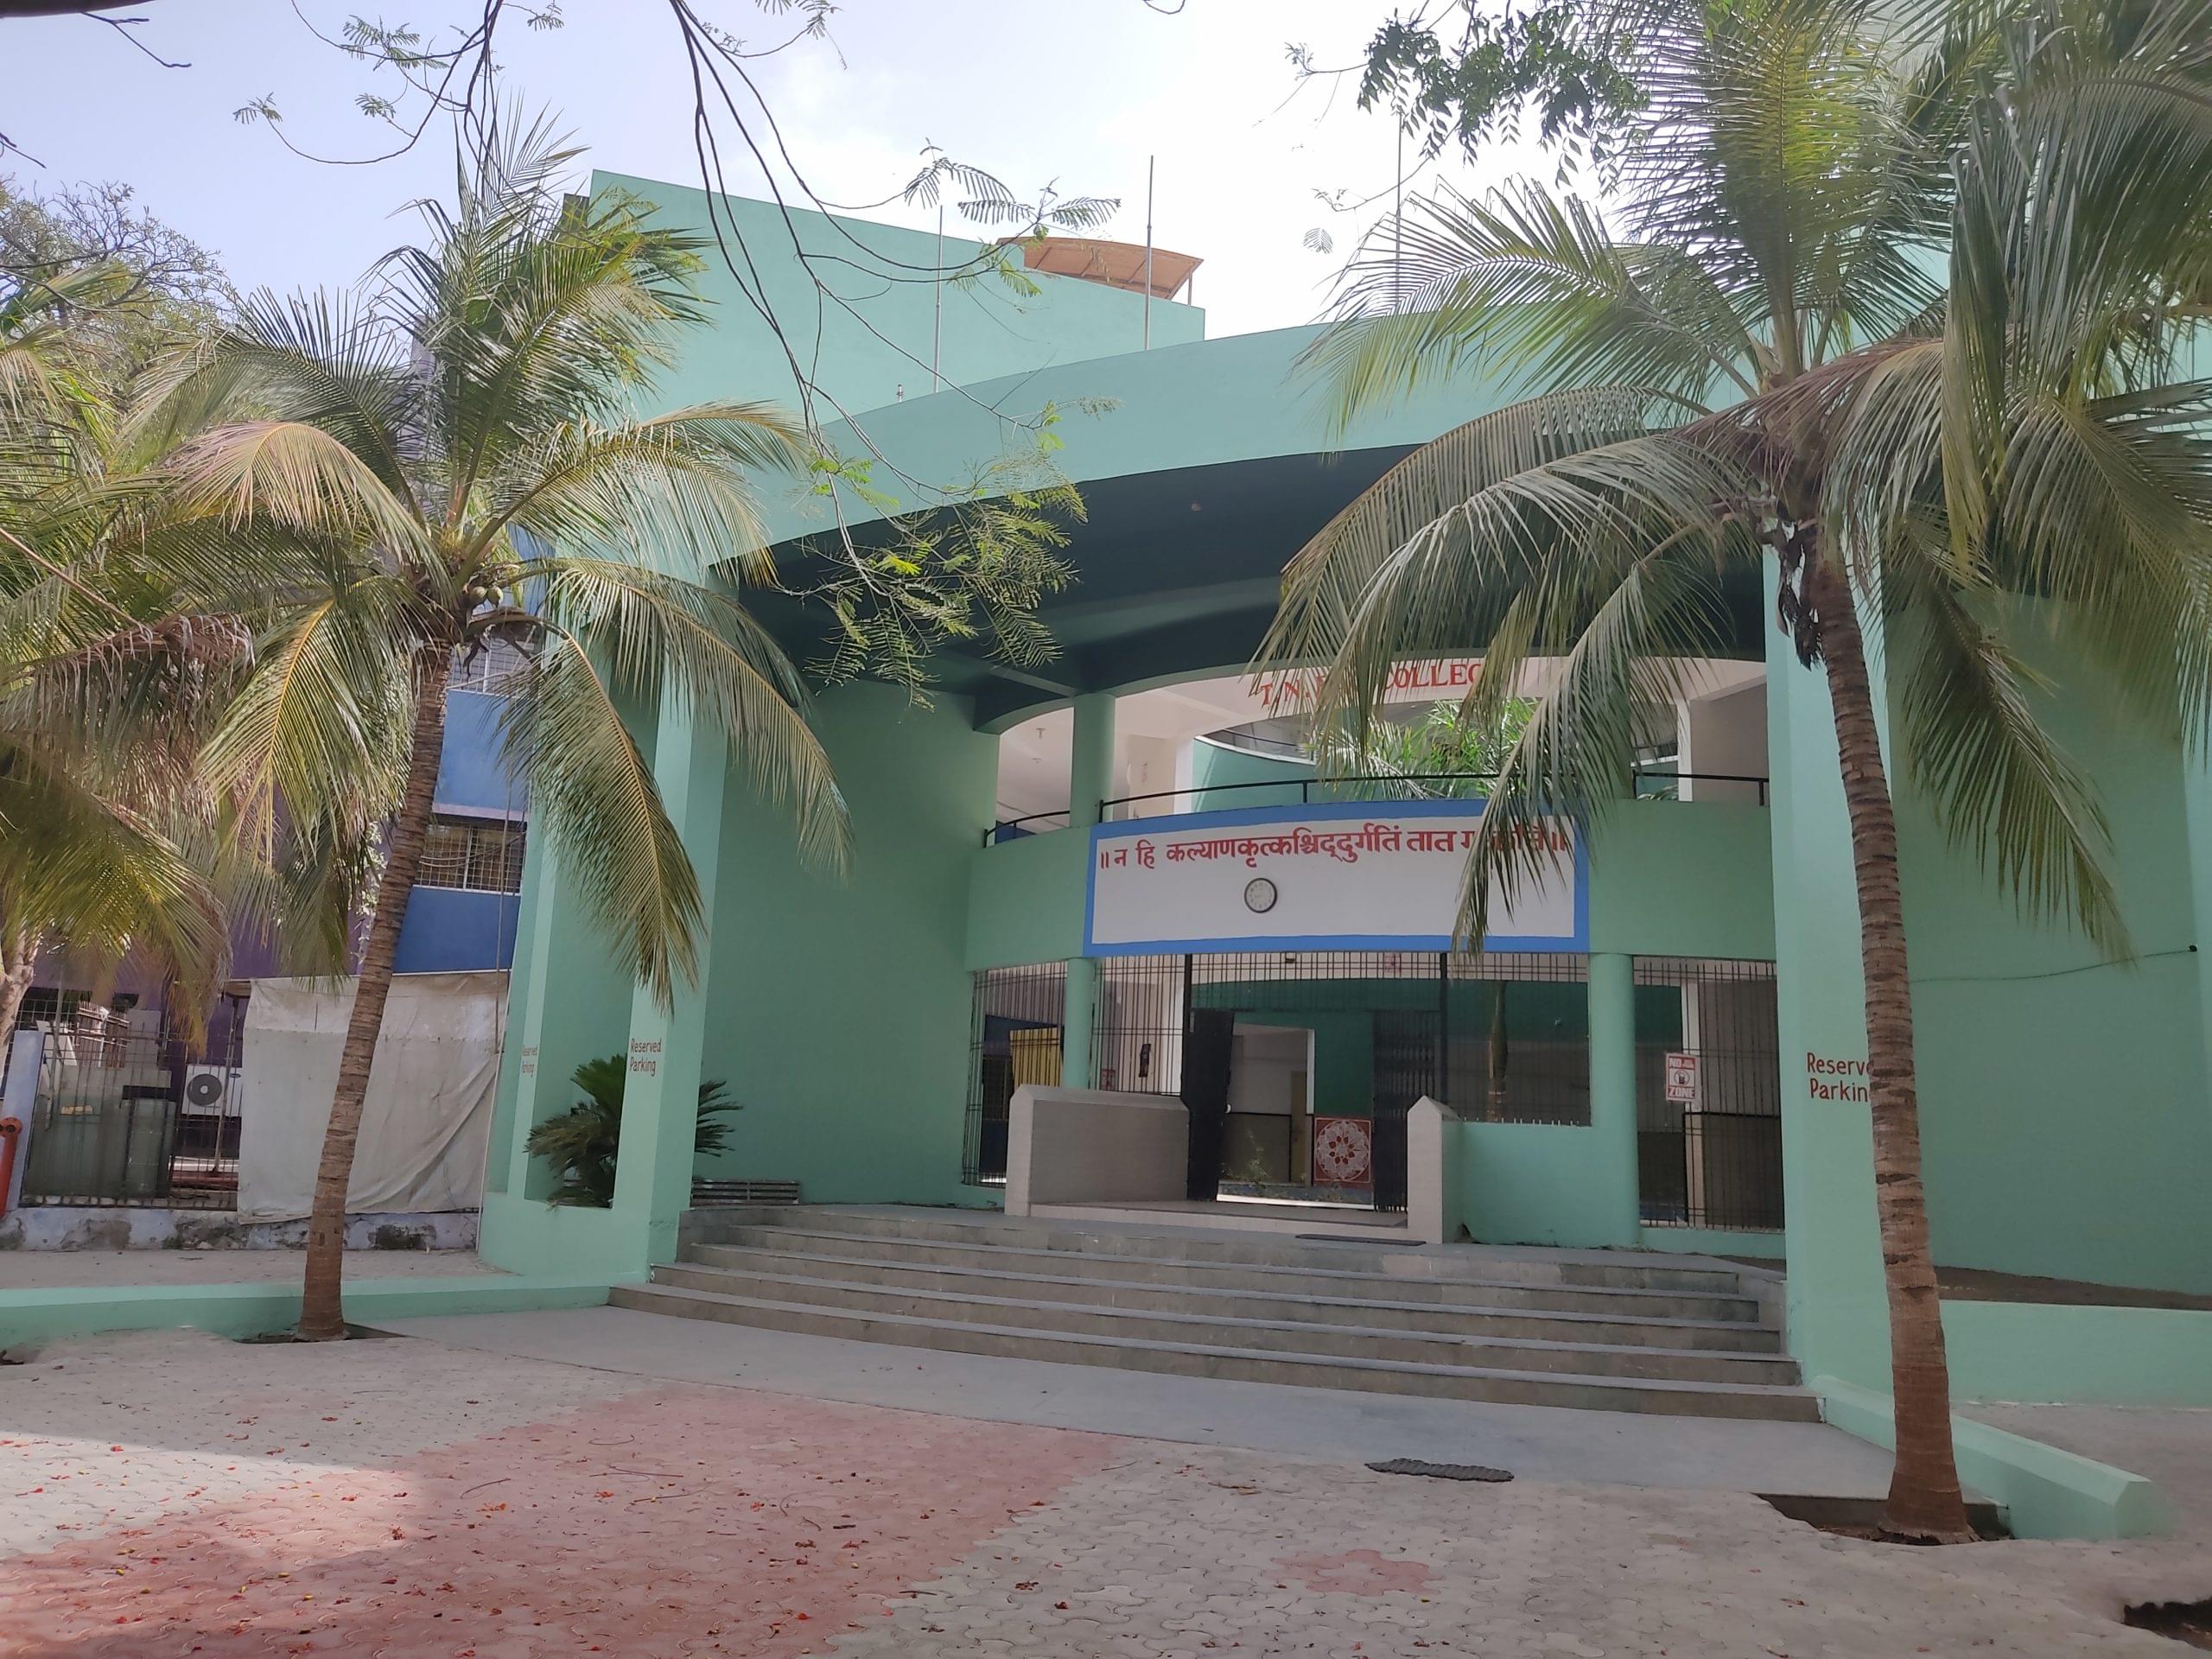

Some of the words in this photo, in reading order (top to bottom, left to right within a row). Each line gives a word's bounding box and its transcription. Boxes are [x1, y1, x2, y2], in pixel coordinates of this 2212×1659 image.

[1135, 839, 1156, 869] हि
[1407, 831, 1458, 852] तात
[631, 1038, 662, 1053] Reserved
[630, 1056, 656, 1077] Parking
[1807, 1052, 1870, 1076] Reserv
[1669, 1087, 1695, 1098] ZONE
[1809, 1077, 1868, 1103] Parkin
